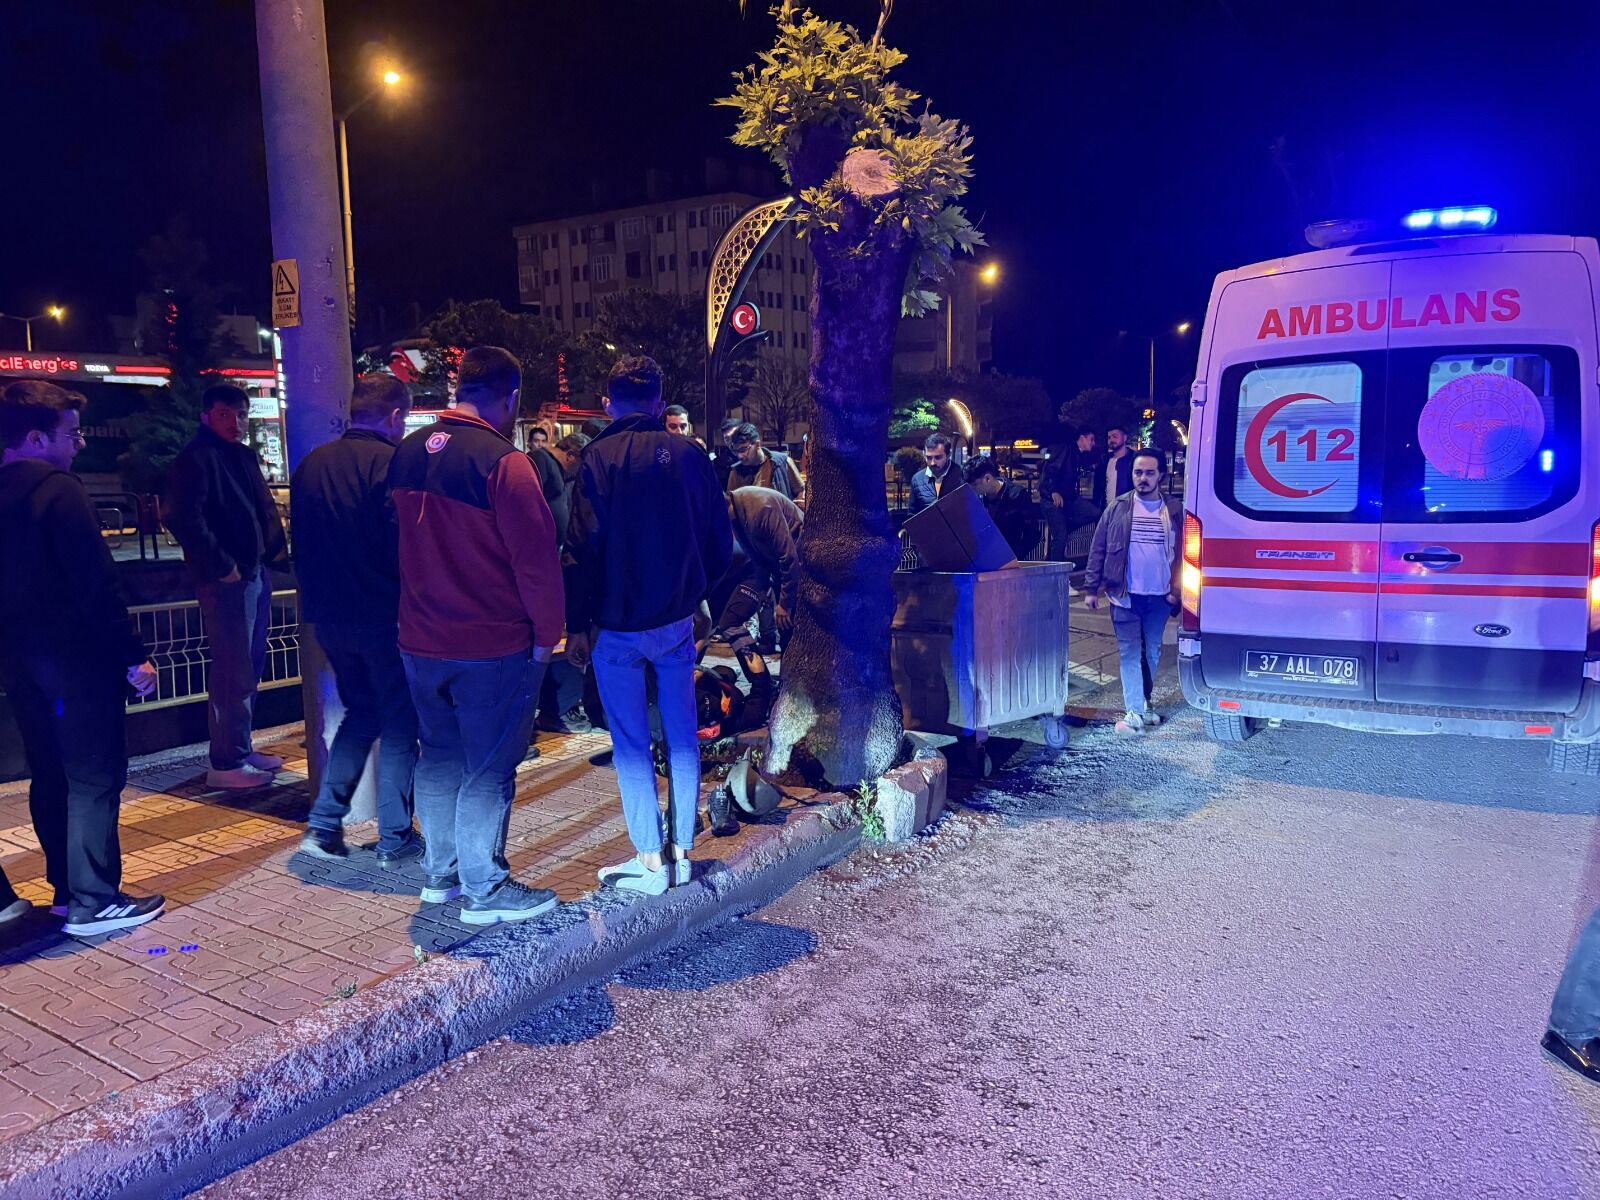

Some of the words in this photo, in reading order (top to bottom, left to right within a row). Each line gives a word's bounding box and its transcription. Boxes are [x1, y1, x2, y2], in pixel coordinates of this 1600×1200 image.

[1257, 289, 1521, 339] AMBULANS
[1267, 428, 1355, 462] 112
[1257, 550, 1334, 560] TRANSIT
[1260, 655, 1278, 671] 37
[1286, 656, 1315, 675] AAL
[1323, 659, 1354, 677] 078
